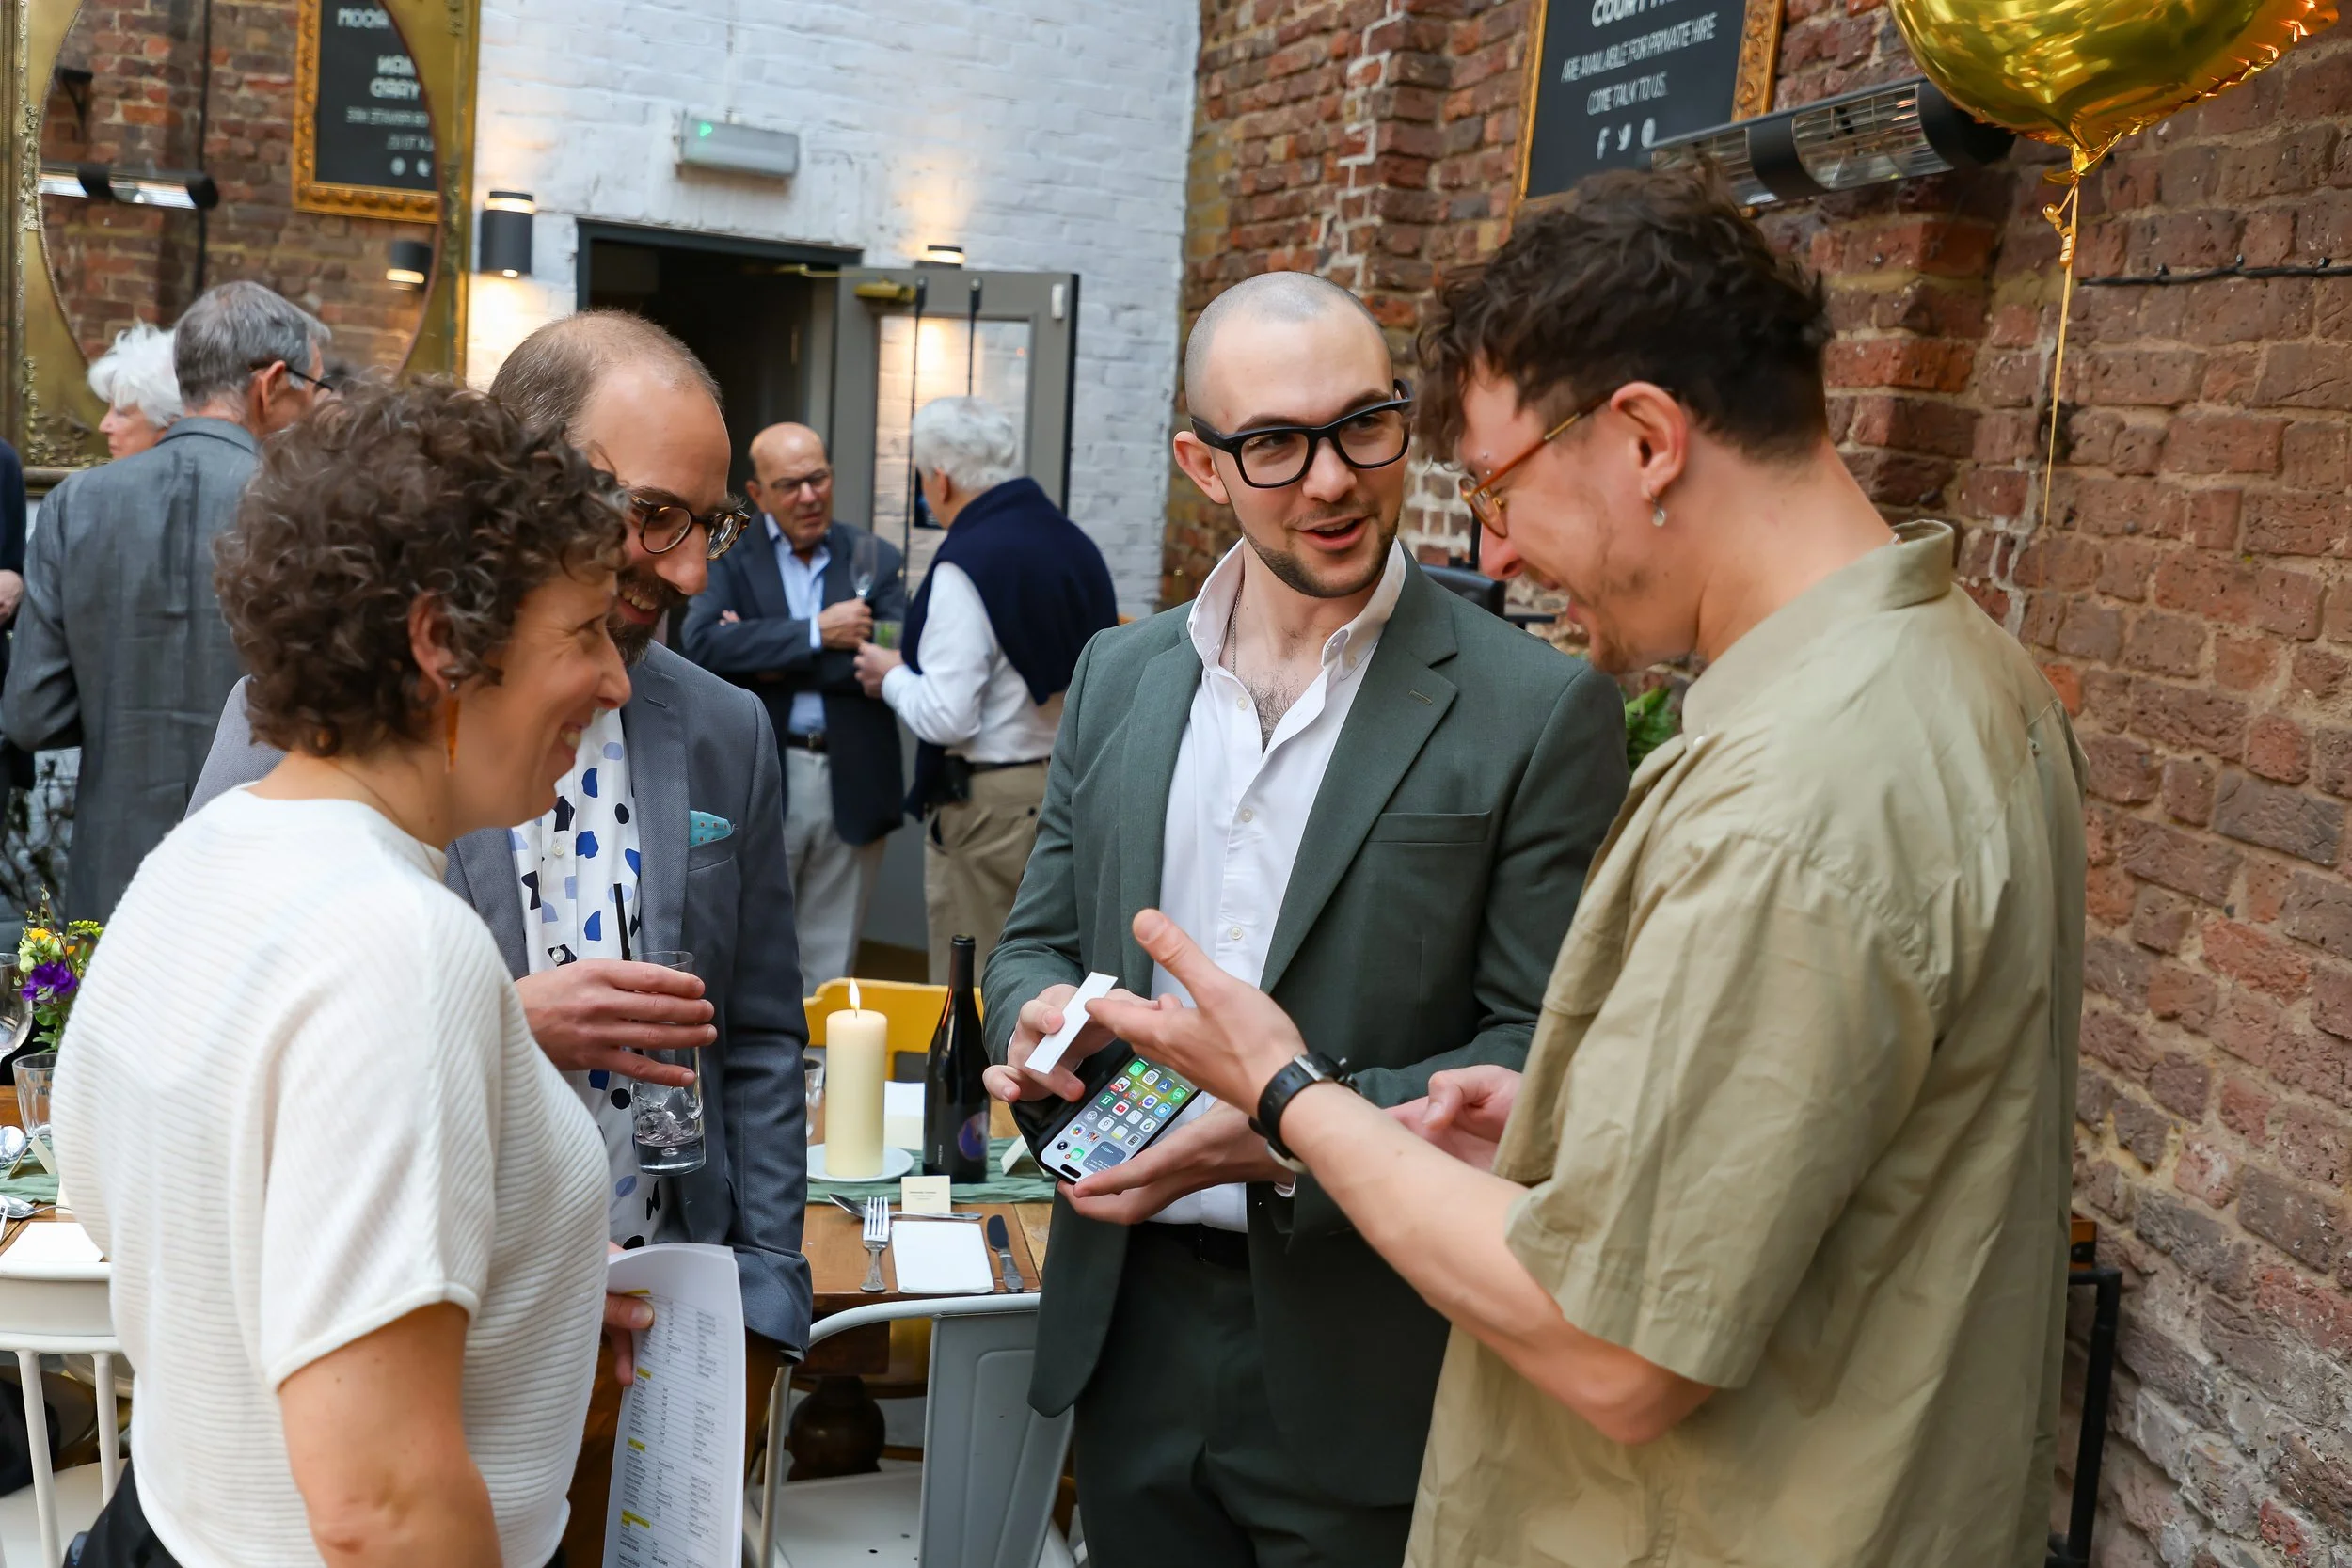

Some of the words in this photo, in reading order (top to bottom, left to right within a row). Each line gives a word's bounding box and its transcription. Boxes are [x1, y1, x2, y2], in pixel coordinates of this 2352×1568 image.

[1561, 55, 1581, 83] ARE
[1579, 40, 1629, 78] AVAILABLE
[1628, 34, 1649, 64] FOR
[1647, 19, 1692, 57] PRIVATE
[1691, 11, 1718, 44] HIRE
[1587, 86, 1613, 116] COME
[1613, 79, 1639, 108] TALK
[1638, 74, 1653, 103] TO
